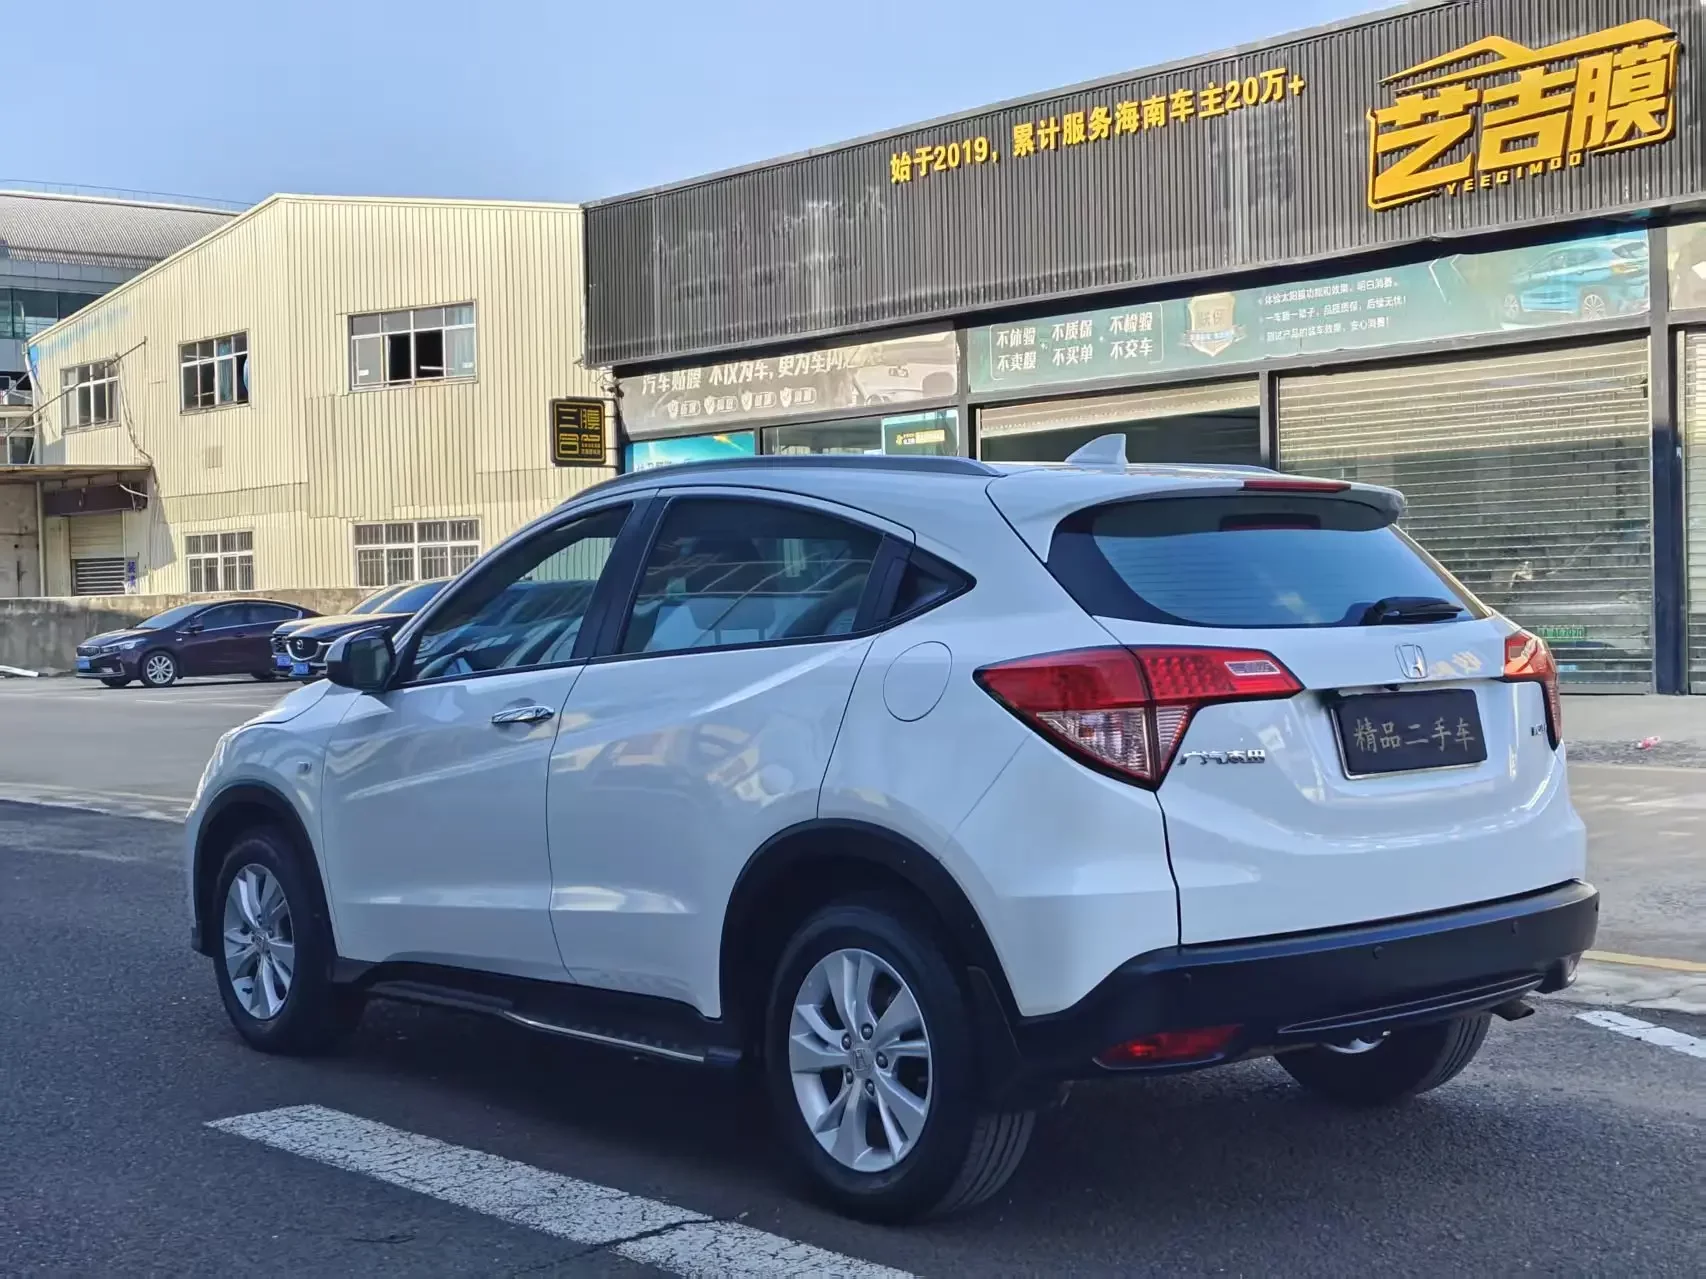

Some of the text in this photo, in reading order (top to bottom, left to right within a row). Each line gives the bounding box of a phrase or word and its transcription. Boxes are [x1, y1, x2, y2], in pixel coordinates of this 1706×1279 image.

[1052, 319, 1093, 342] 不质保
[1052, 343, 1093, 367] 不买单
[1110, 337, 1153, 360] 不交车
[997, 351, 1037, 373] 不卖膜
[1353, 716, 1477, 754] 精品二手车
